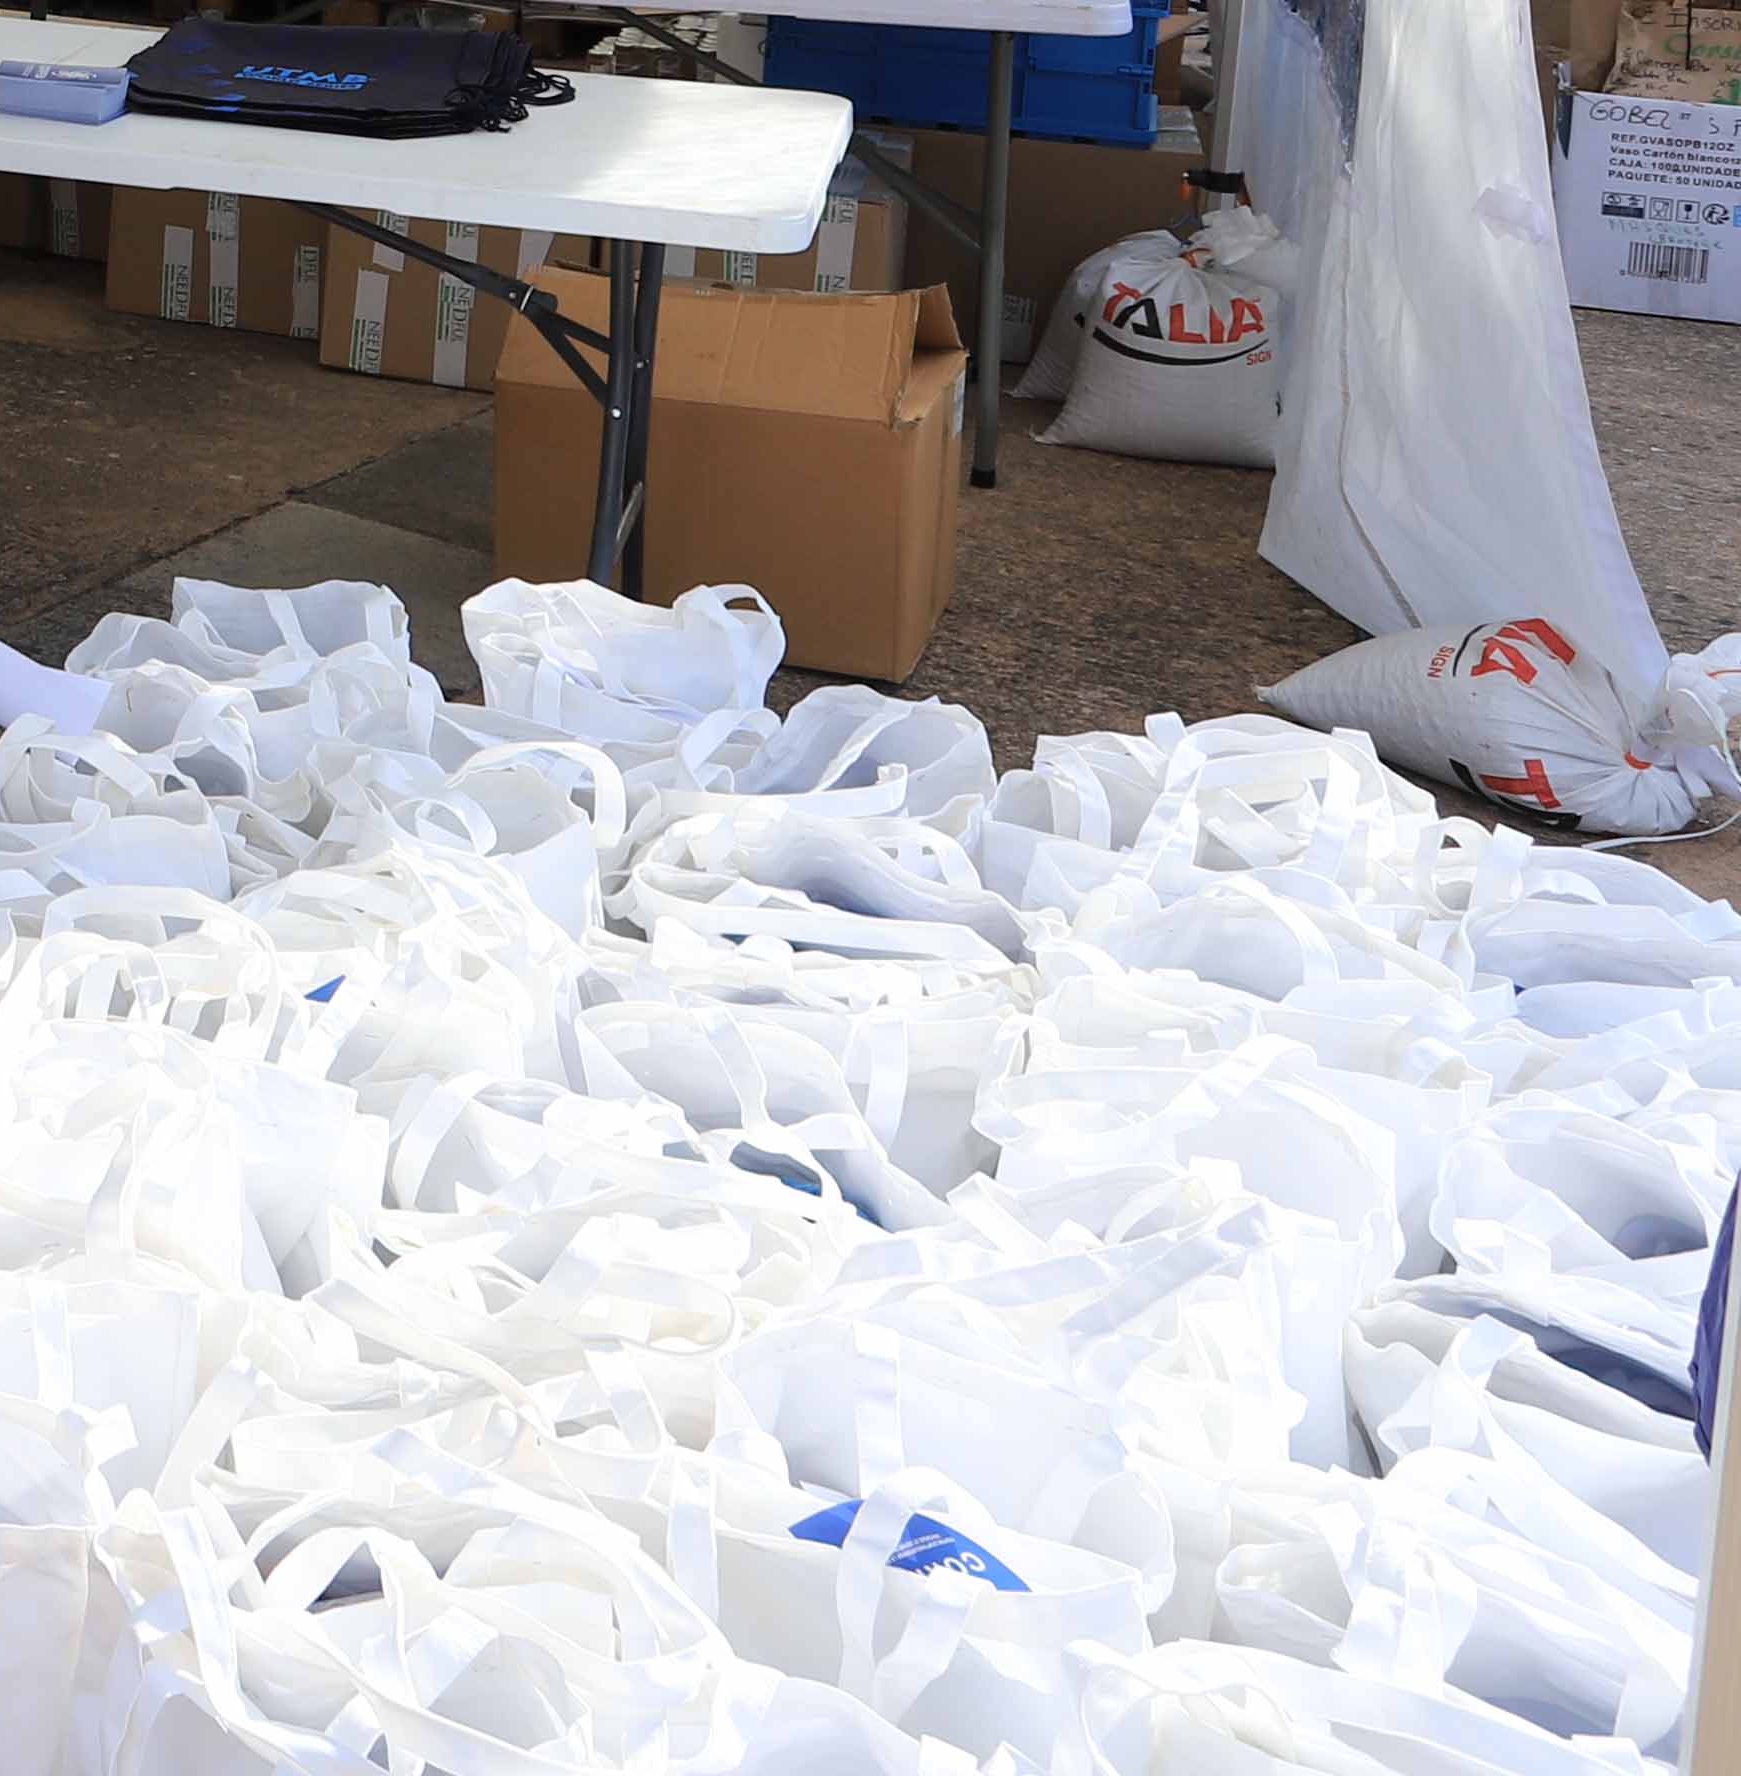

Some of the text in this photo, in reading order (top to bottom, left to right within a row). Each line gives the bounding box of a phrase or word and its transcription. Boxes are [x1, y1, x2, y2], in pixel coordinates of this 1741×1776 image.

[242, 65, 370, 84] UTMB
[1611, 146, 1640, 156] Vaso
[1642, 148, 1685, 161] Cartón
[1609, 158, 1647, 169] CAJA:
[1608, 169, 1673, 185] PAQUETE:
[1676, 177, 1691, 186] 50
[1103, 282, 1265, 344] TALIA
[1427, 645, 1457, 678] SIGN
